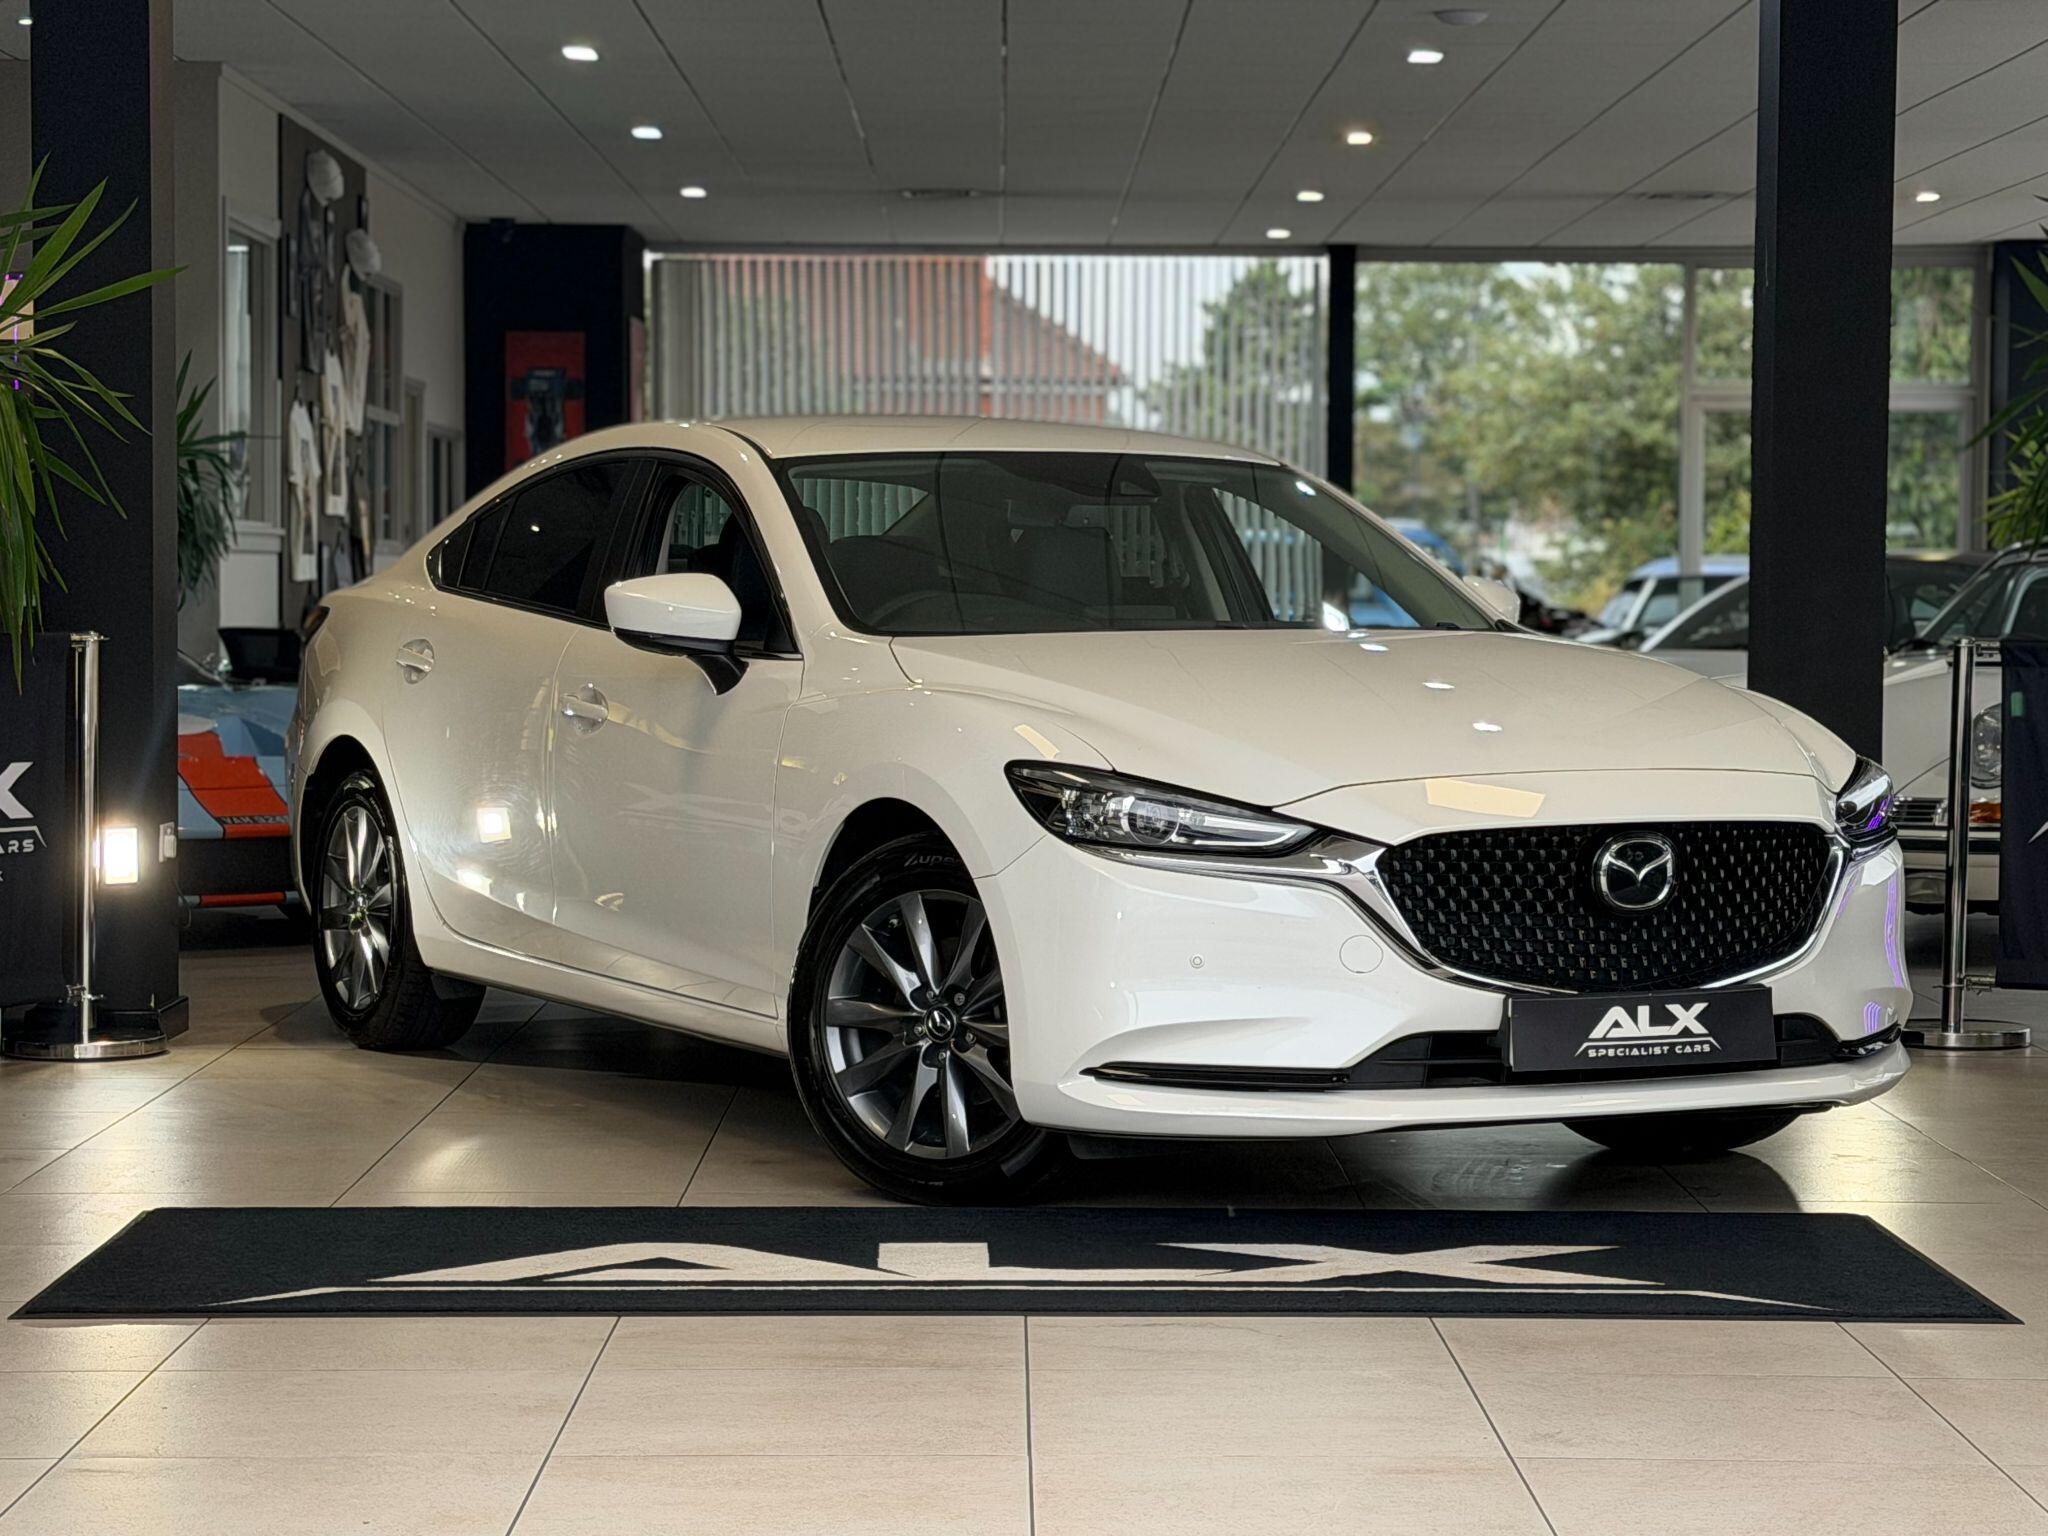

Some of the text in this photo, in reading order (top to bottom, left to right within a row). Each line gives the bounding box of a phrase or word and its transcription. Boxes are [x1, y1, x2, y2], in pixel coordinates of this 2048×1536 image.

[904, 853, 963, 867] Zupe
[1588, 1002, 1710, 1039] ALX
[1588, 1043, 1711, 1058] SPECIALIST CARS
[366, 1241, 1665, 1285] ALX
